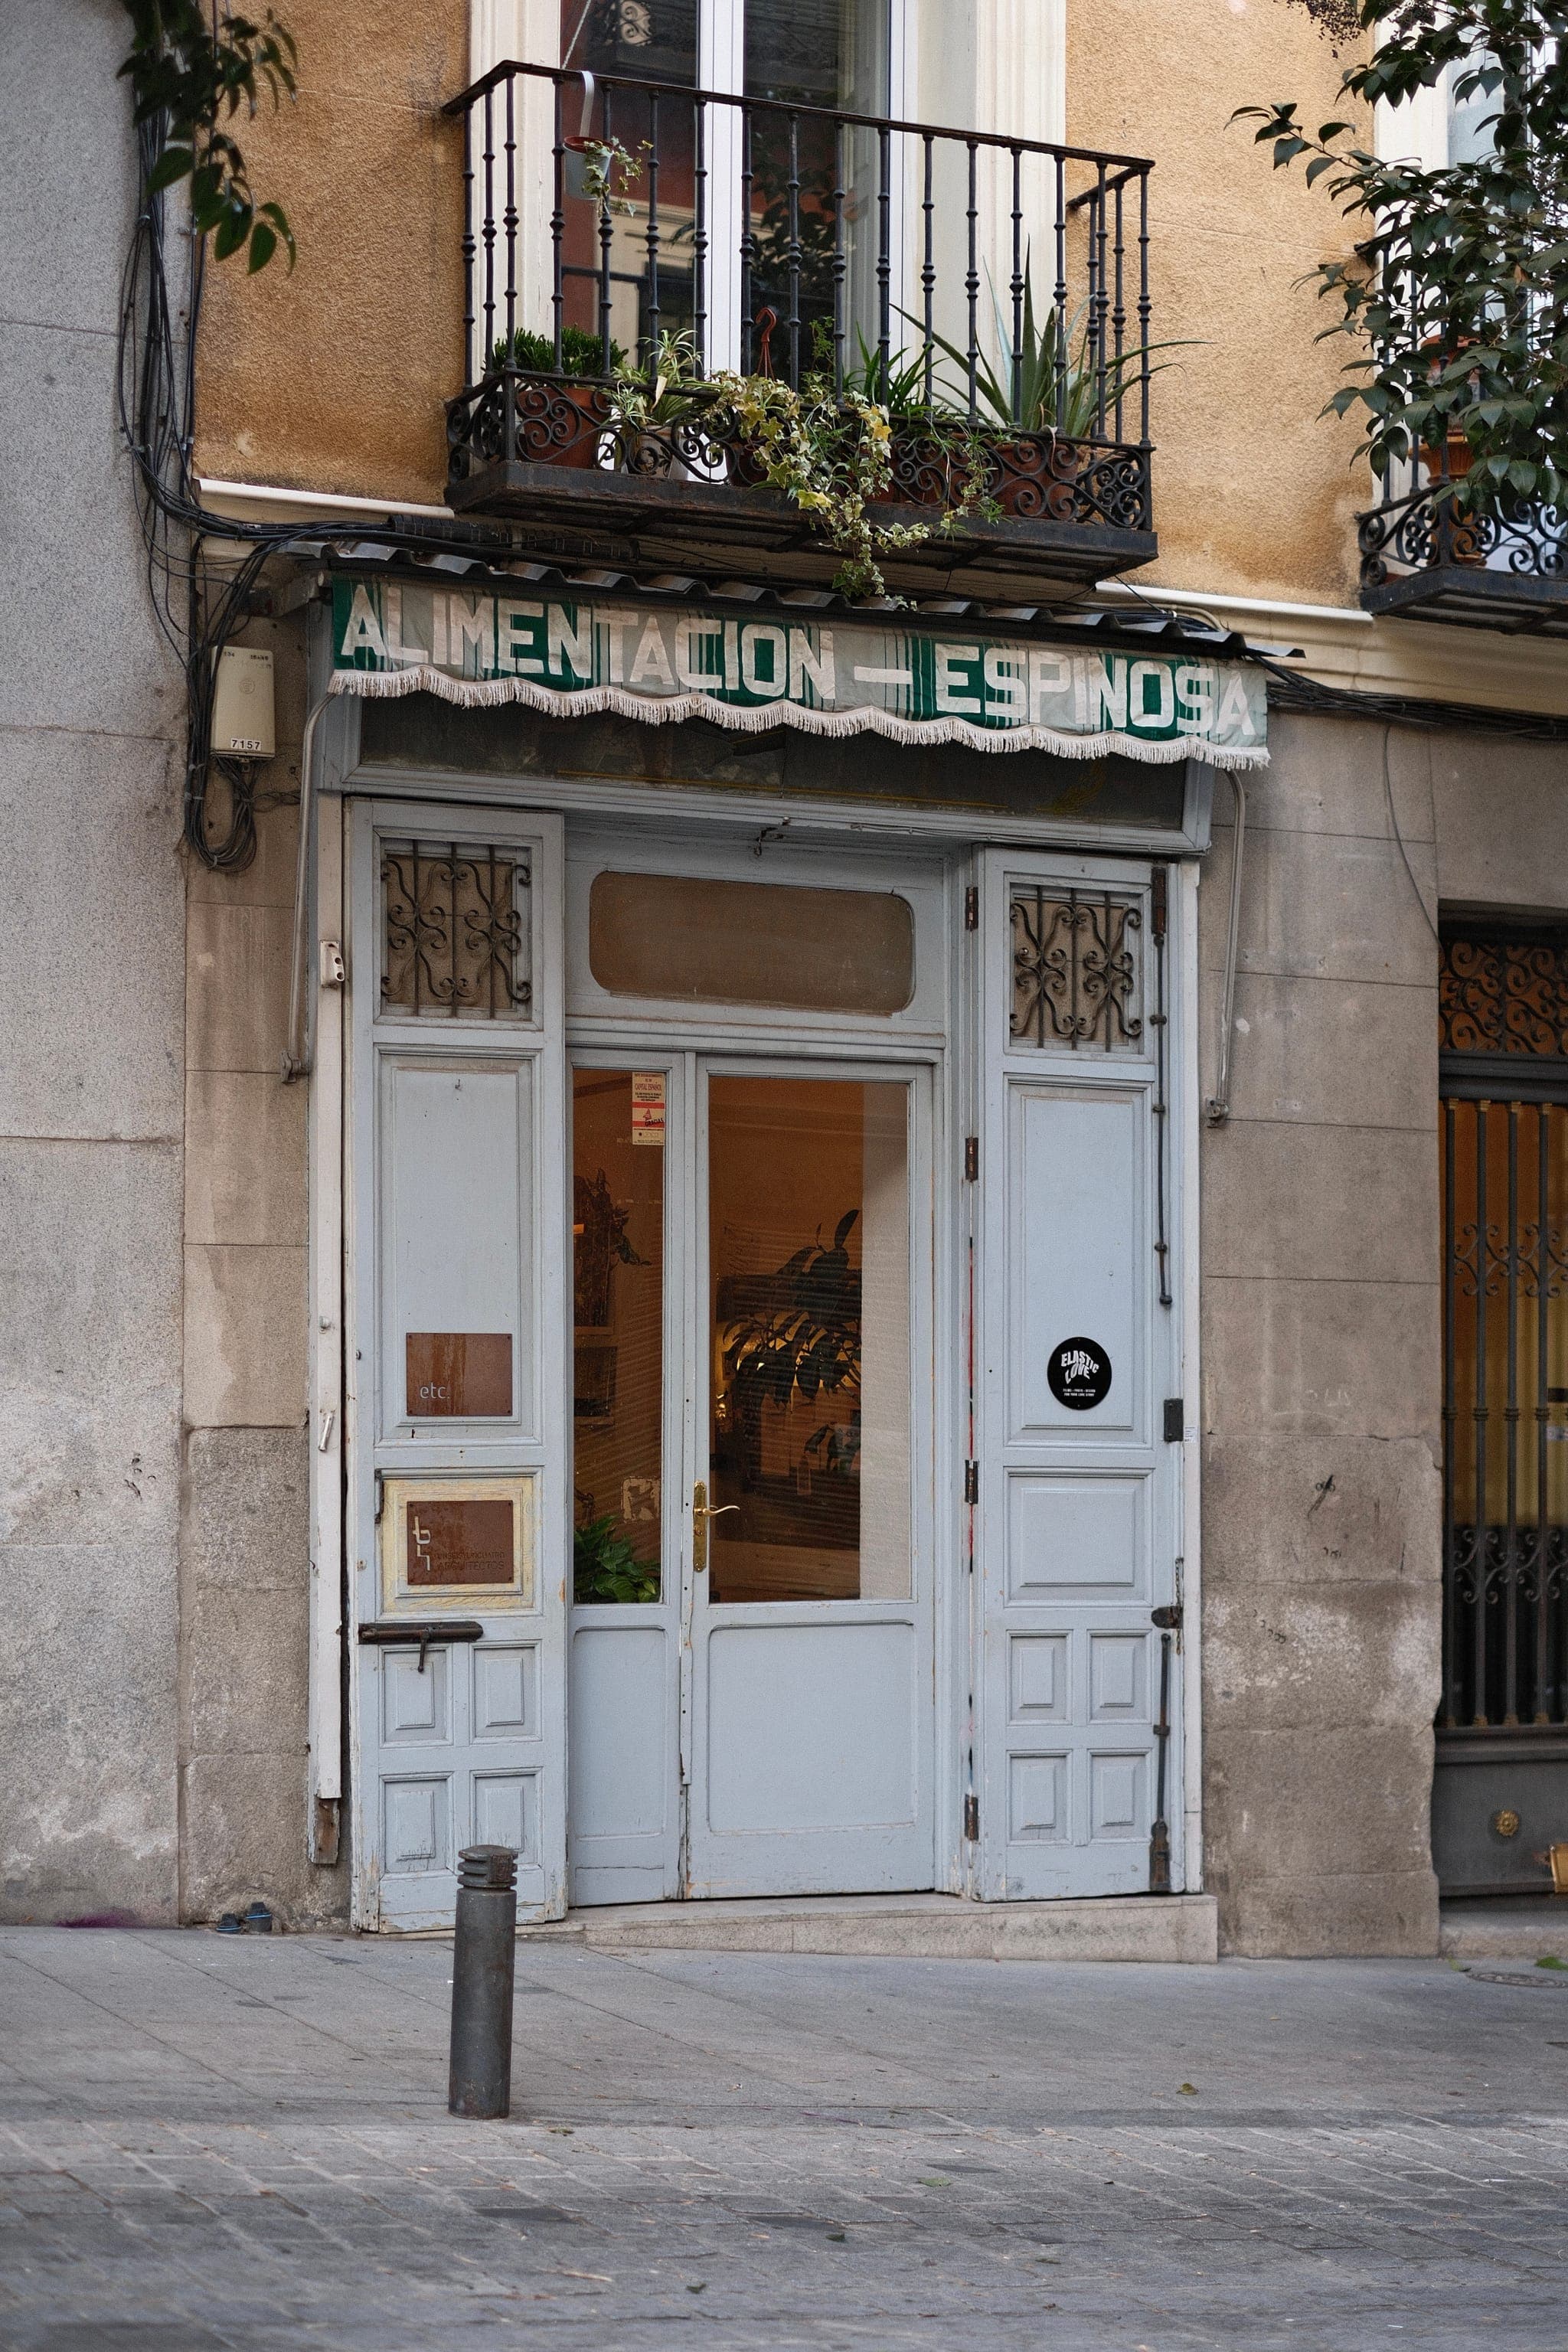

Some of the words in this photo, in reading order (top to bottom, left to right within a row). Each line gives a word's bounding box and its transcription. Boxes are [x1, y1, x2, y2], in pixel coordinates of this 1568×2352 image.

[341, 584, 836, 700] ALIMENTACION
[935, 643, 1256, 736] ESPINOSA
[232, 740, 260, 750] 7157
[1060, 1350, 1099, 1374] ELASTIC
[1065, 1363, 1090, 1384] LOVE
[420, 1382, 450, 1399] etc.
